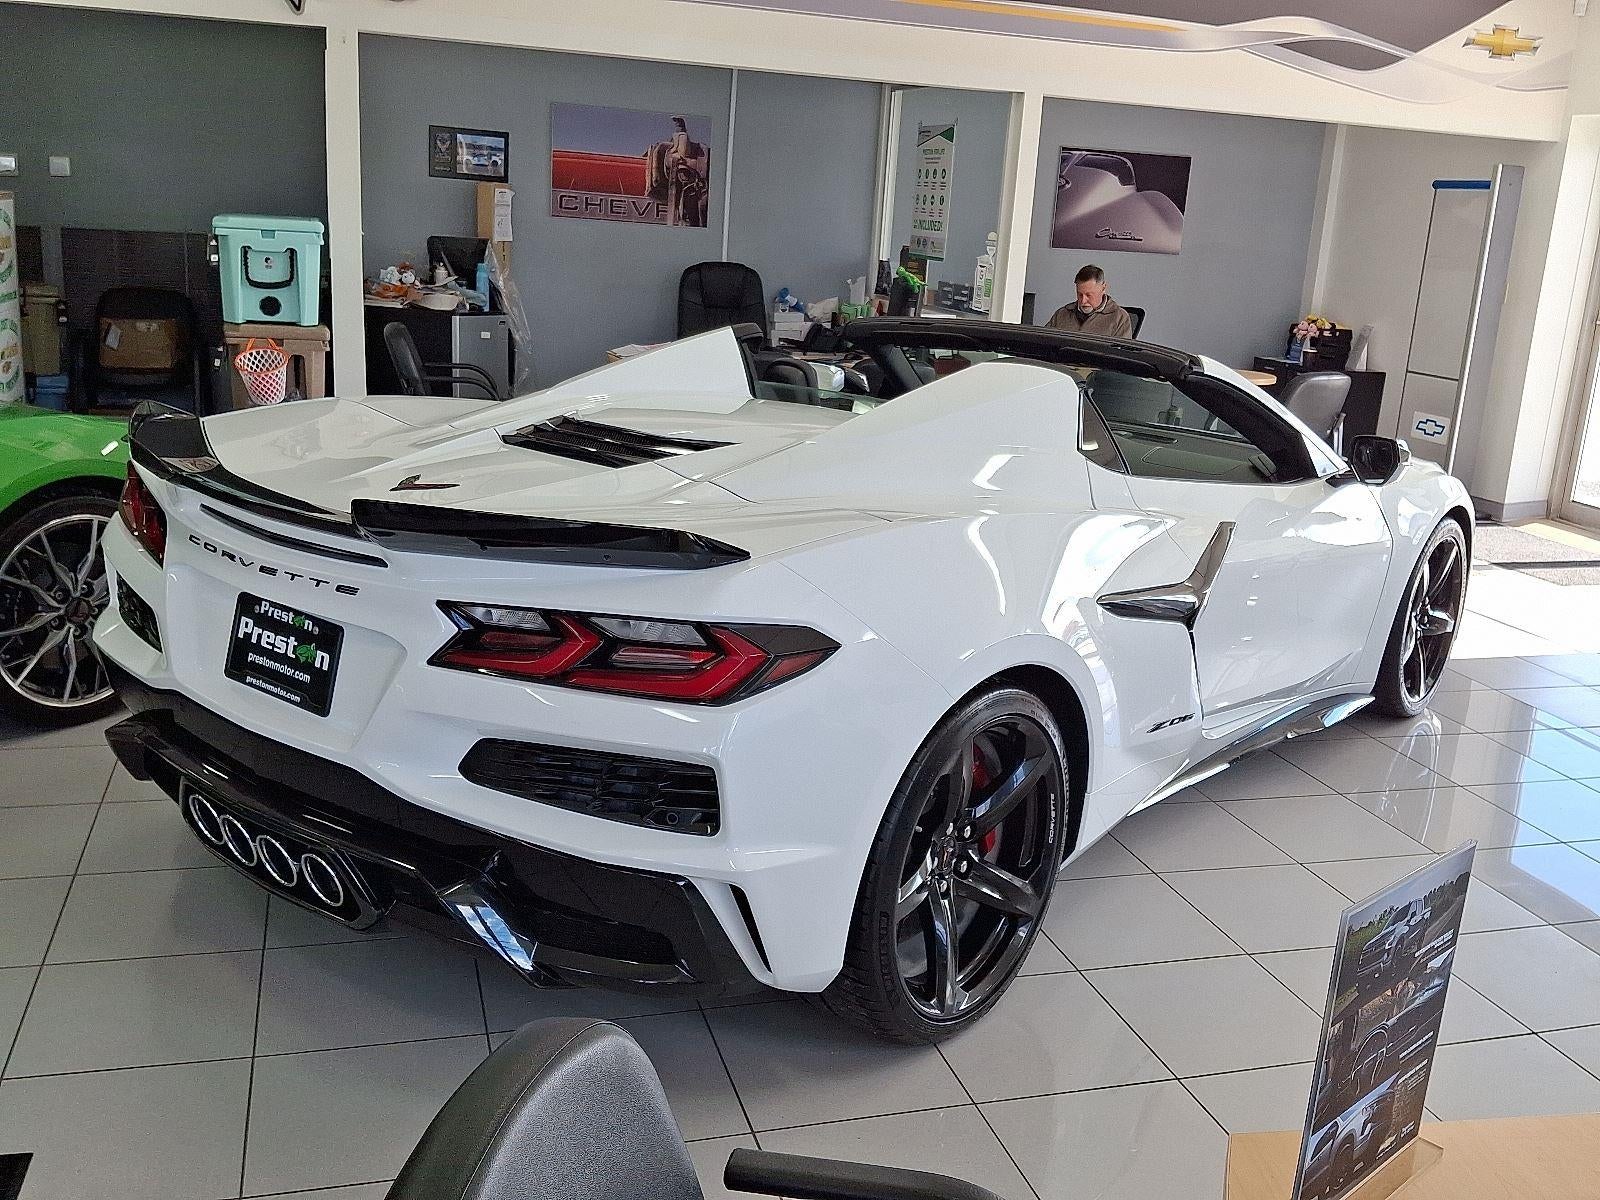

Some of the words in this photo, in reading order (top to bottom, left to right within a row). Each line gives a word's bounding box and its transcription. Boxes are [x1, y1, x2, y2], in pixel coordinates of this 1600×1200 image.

[188, 534, 360, 596] CORVETTE
[248, 652, 311, 684] prestonmotor.com
[246, 675, 301, 703] prestonmotor.com
[1146, 712, 1195, 733] Z06
[1048, 793, 1056, 844] CORVETTE
